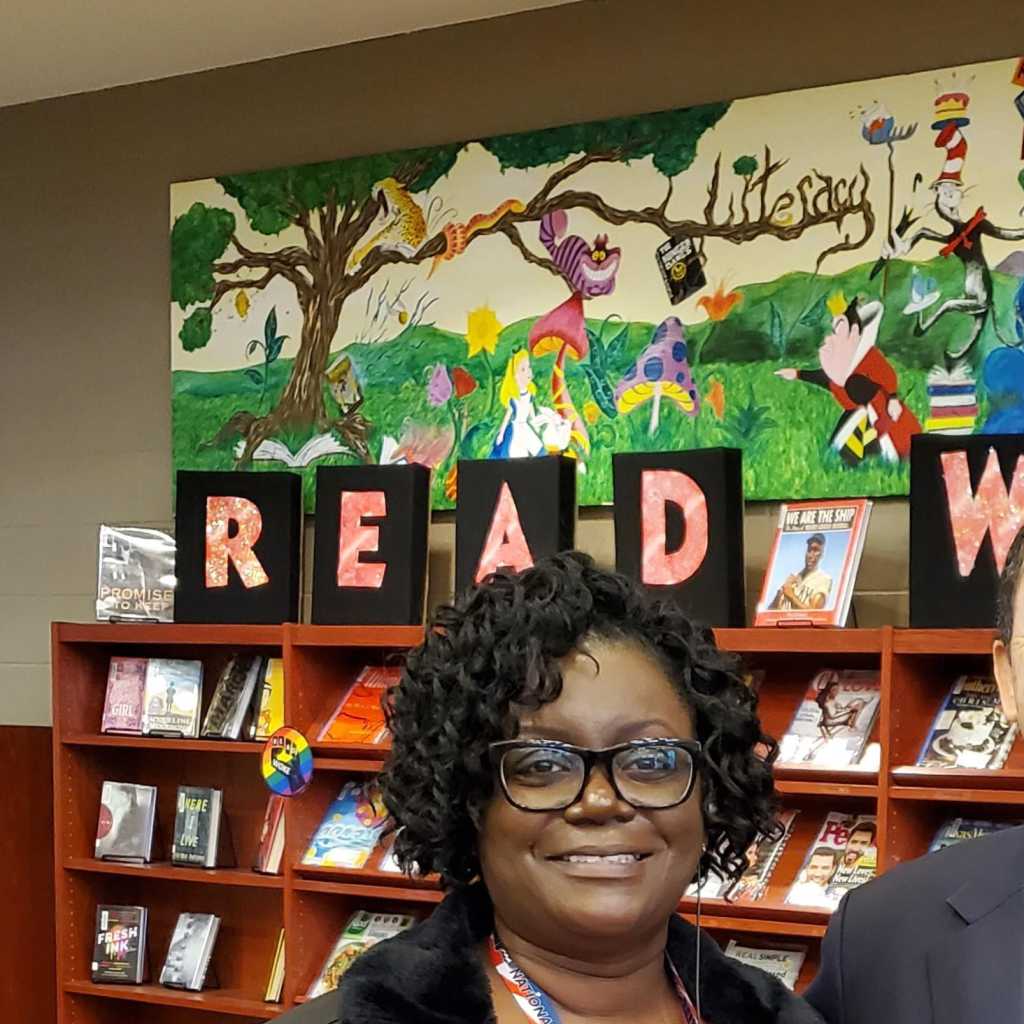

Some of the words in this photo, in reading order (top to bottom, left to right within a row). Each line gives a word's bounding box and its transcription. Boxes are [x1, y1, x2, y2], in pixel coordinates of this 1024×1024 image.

[786, 511, 800, 525] WE
[800, 510, 817, 524] ARE
[818, 509, 834, 523] THE
[834, 508, 855, 522] SHIP
[100, 586, 173, 600] PROMISE
[114, 601, 130, 610] TO
[111, 704, 135, 717] GIRL
[185, 798, 208, 813] HERE
[180, 834, 199, 848] LIVE
[97, 926, 138, 944] FRESH
[105, 940, 129, 955] INK
[760, 953, 790, 962] SIMPLE
